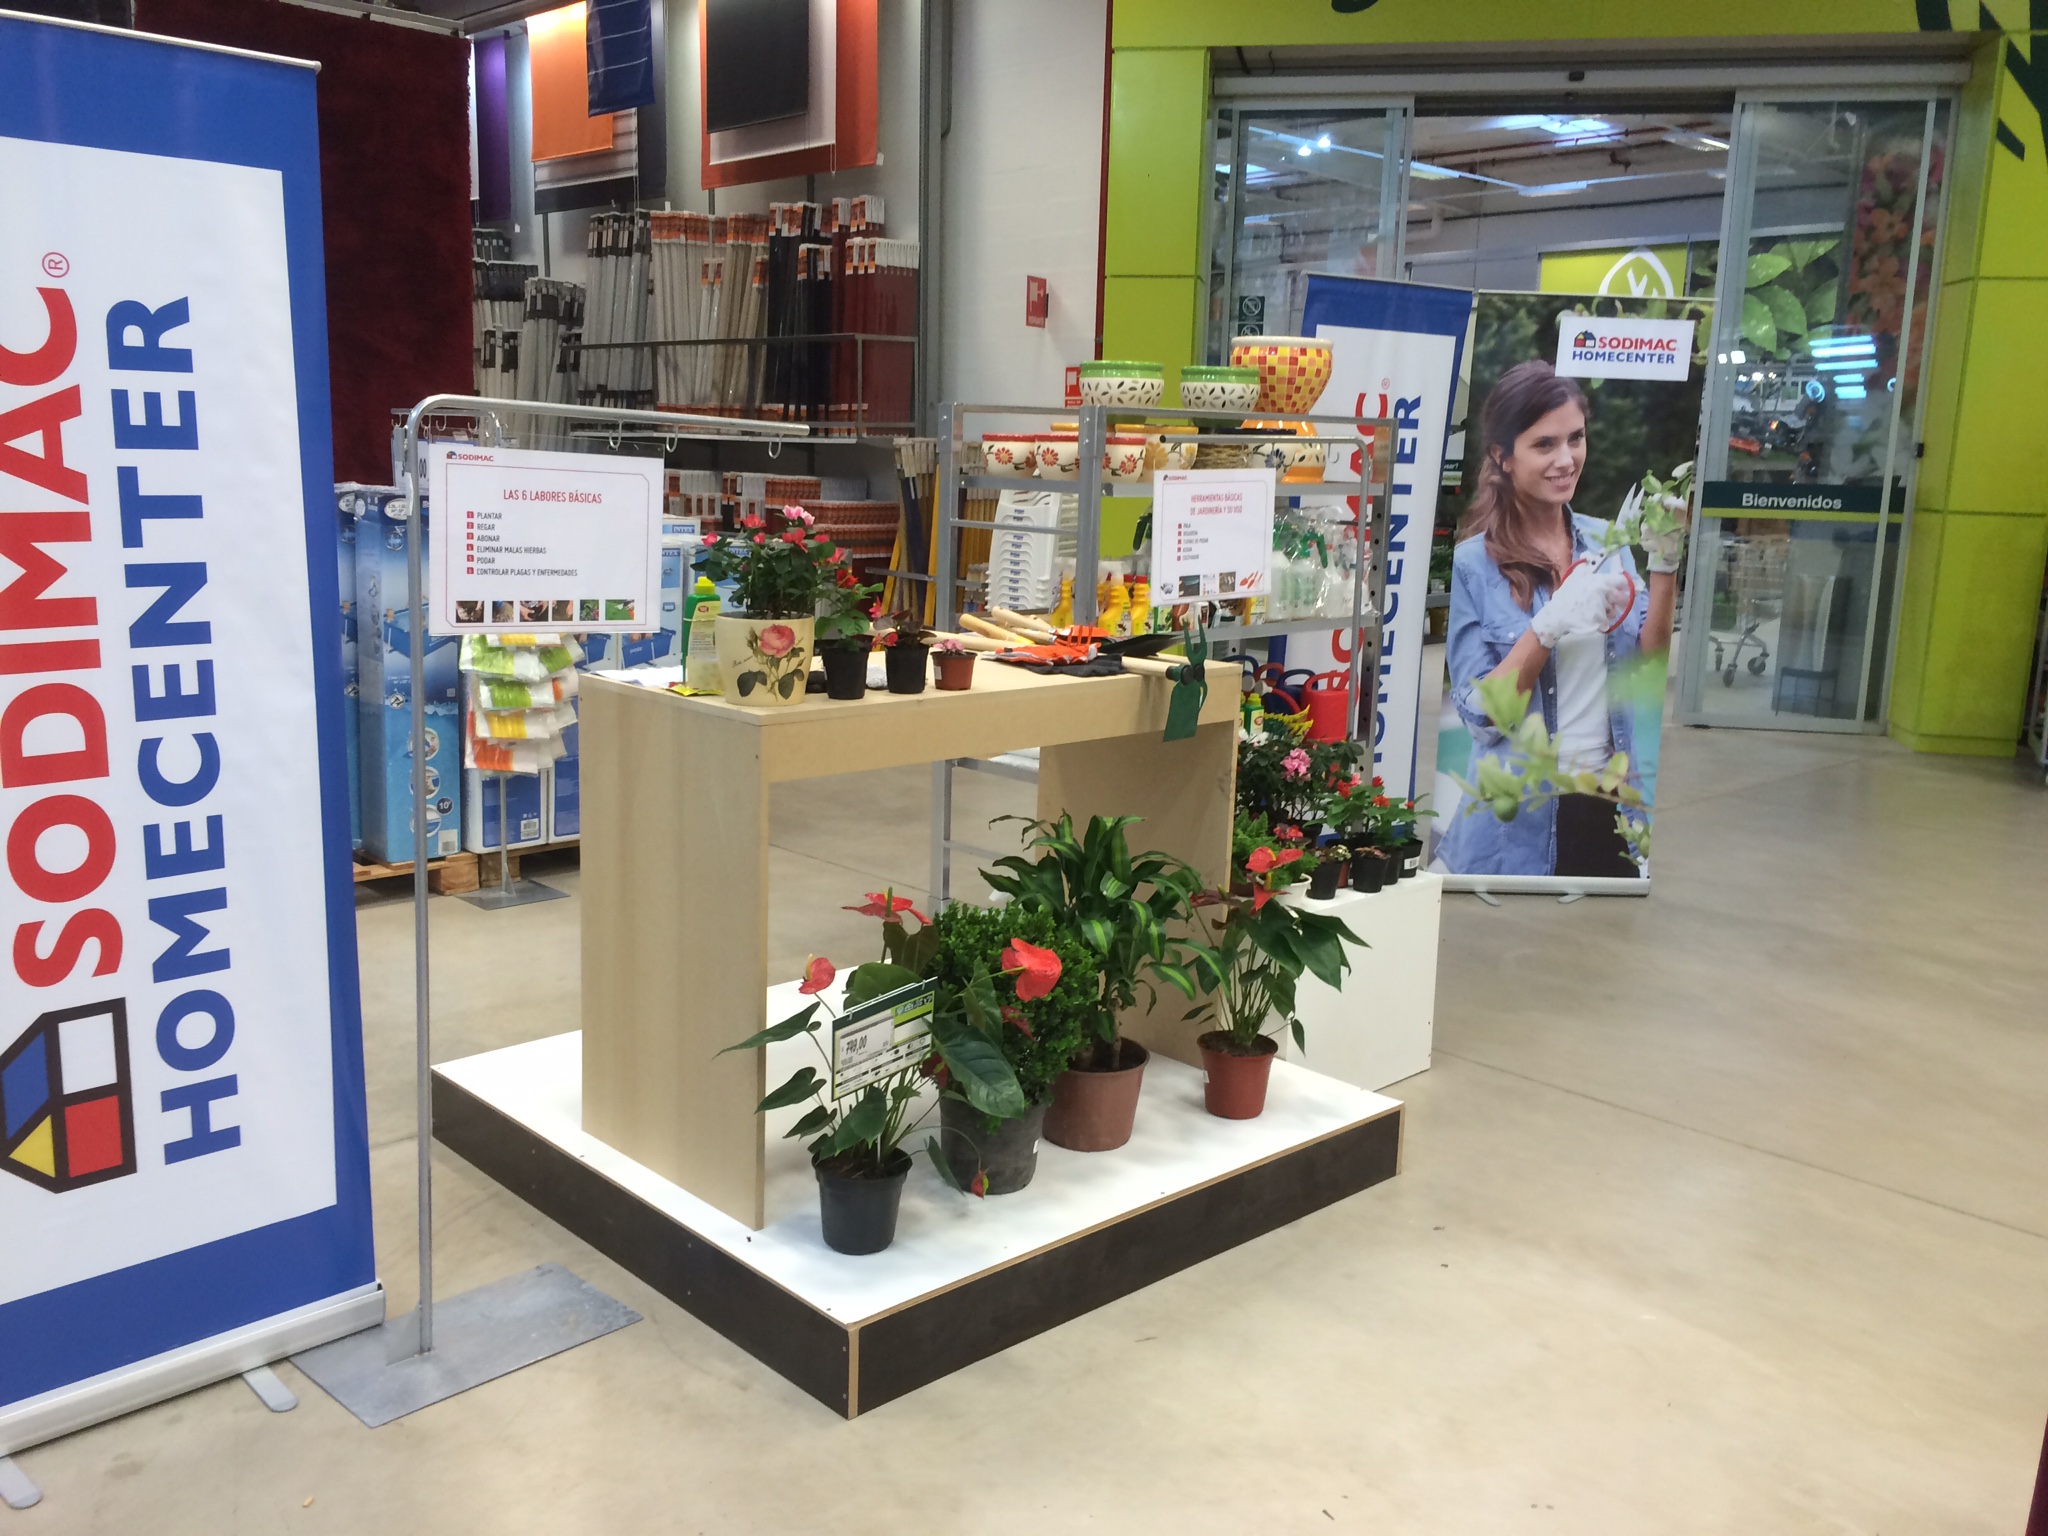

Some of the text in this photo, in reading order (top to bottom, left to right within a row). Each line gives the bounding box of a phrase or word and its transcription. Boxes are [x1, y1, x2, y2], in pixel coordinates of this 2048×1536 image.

[1598, 337, 1677, 351] SODIMAC
[1572, 350, 1675, 364] HOMECENTER
[458, 453, 494, 462] SODIMAC
[503, 489, 602, 504] LAS 6 LABORES BÁSICAS
[1191, 493, 1224, 503] HERRAMIENTAS
[1742, 493, 1842, 510] Bienvenidos
[477, 512, 502, 520] PLANTAR
[1190, 507, 1196, 516] DE
[477, 523, 495, 531] REGAR
[504, 546, 522, 554] MALAS
[477, 568, 509, 576] CONTROLAR
[537, 569, 578, 577] ENFERMEDADES
[106, 296, 241, 1165] HOMECENTER
